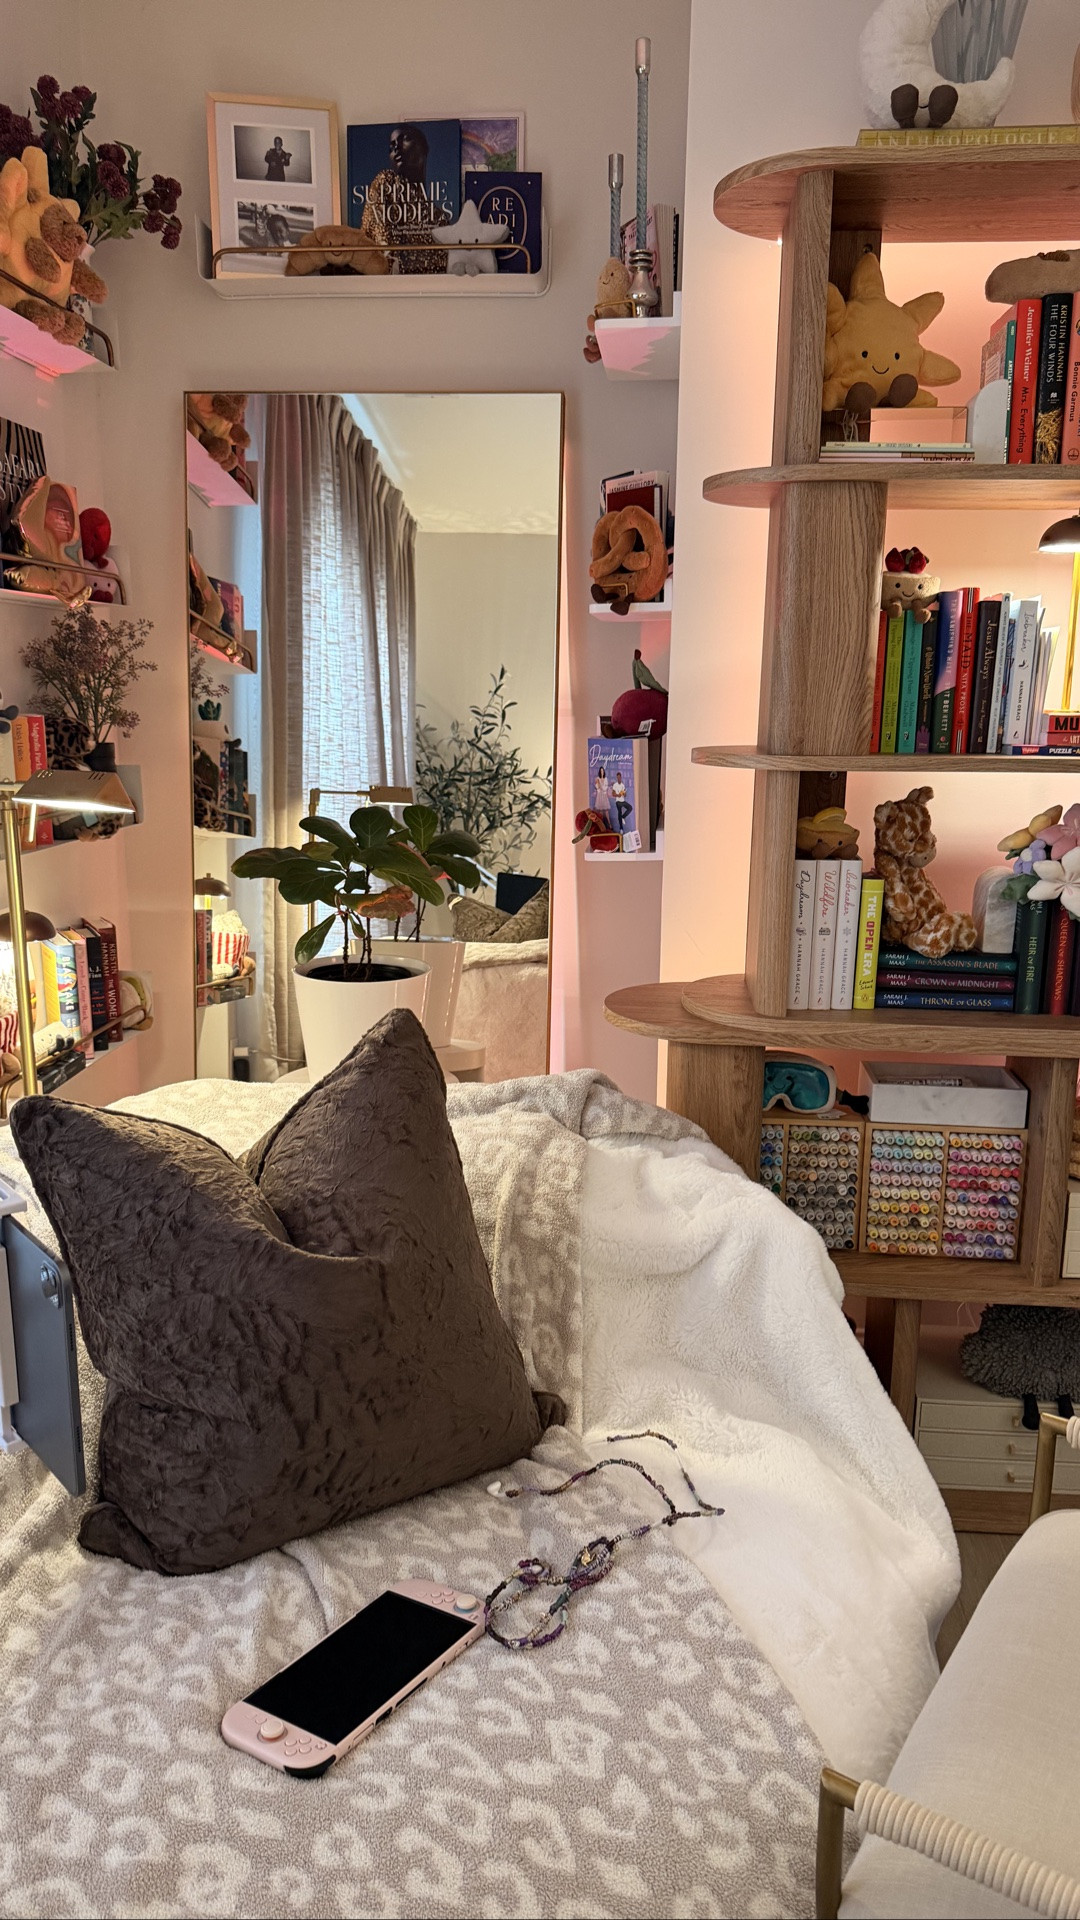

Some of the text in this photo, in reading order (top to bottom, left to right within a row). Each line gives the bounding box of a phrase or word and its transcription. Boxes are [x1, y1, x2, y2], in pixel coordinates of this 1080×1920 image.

[874, 131, 1058, 147] ANTHROPOLOGIE
[352, 181, 448, 204] SUPREME
[372, 201, 453, 224] MODELS
[1023, 306, 1035, 382] Jennifer Weiner
[1046, 304, 1059, 383] THE FOUR WINDS
[1056, 304, 1068, 382] KRISTIN HANNAH
[1069, 362, 1080, 422] Bonnie Garmus
[1016, 386, 1030, 454] Mrs. Everything
[947, 615, 956, 654] VANISHING
[986, 620, 997, 645] Jesus
[961, 632, 973, 670] MAID
[979, 646, 995, 680] Always
[960, 671, 969, 689] NITA
[941, 700, 949, 731] BENNETT
[958, 691, 967, 714] PROSE
[1054, 717, 1080, 731] MU
[589, 744, 633, 769] Daydream
[796, 870, 811, 919] Daydream
[819, 871, 837, 918] Wildfire
[844, 869, 858, 916] Icebreaker
[862, 896, 877, 976] THE OPEN ERA
[1028, 936, 1037, 955] HEIR
[1060, 918, 1070, 947] QUEEN
[62, 956, 74, 985] BLACK
[101, 942, 110, 977] HANNAH
[108, 943, 118, 975] KRISTIN
[927, 959, 972, 968] ASSASSIN'S
[973, 962, 999, 970] BLADE
[1025, 966, 1035, 983] FIRE
[914, 977, 947, 986] CROWN
[957, 979, 1000, 989] MIDNIGHT
[1054, 959, 1065, 1001] SHADOWS
[65, 986, 75, 1011] CAKE
[108, 989, 118, 1020] WOME
[920, 997, 955, 1005] THRONE
[966, 998, 992, 1007] GLASS
